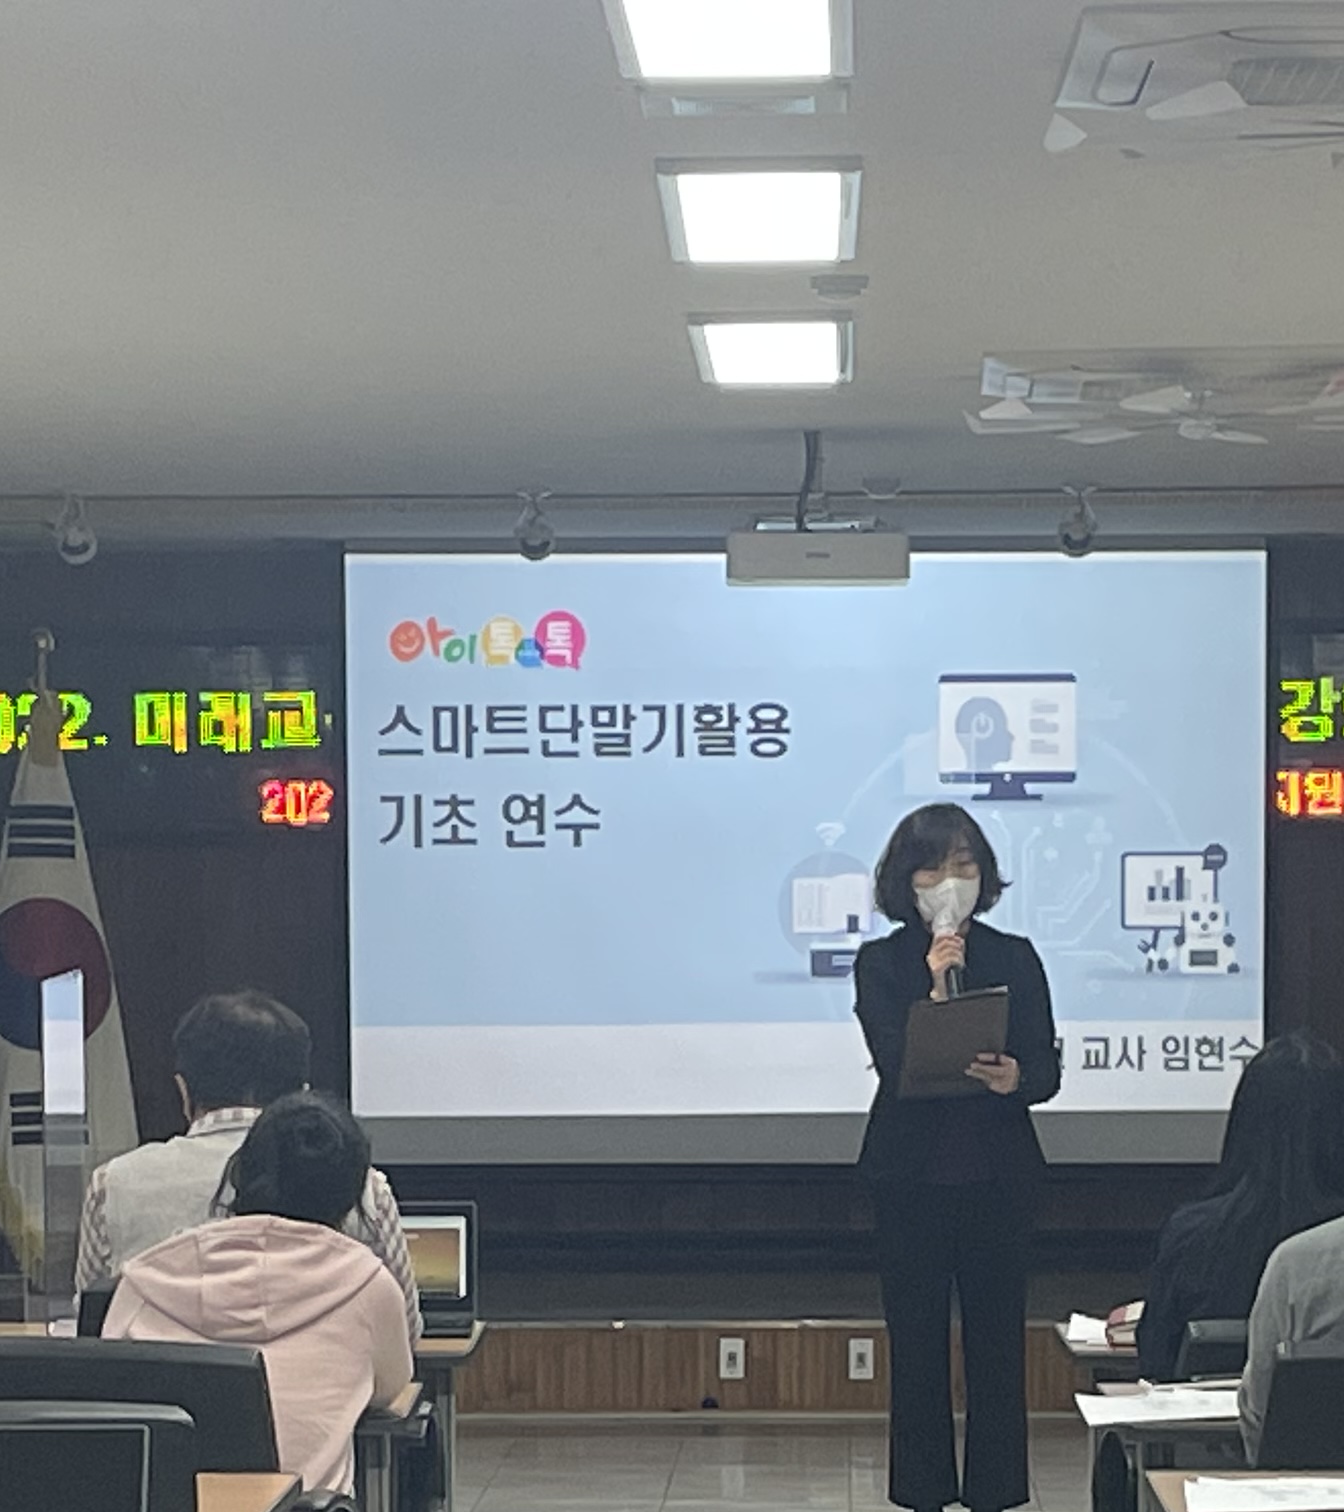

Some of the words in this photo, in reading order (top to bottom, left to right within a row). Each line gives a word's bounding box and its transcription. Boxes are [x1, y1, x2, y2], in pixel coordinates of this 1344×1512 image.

[132, 690, 331, 754] 미래교
[378, 702, 792, 759] 스마트단말기활용
[379, 793, 479, 849] 기초
[501, 793, 602, 849] 연수
[1082, 1036, 1147, 1071] 교사
[1161, 1035, 1259, 1071] 임현수
